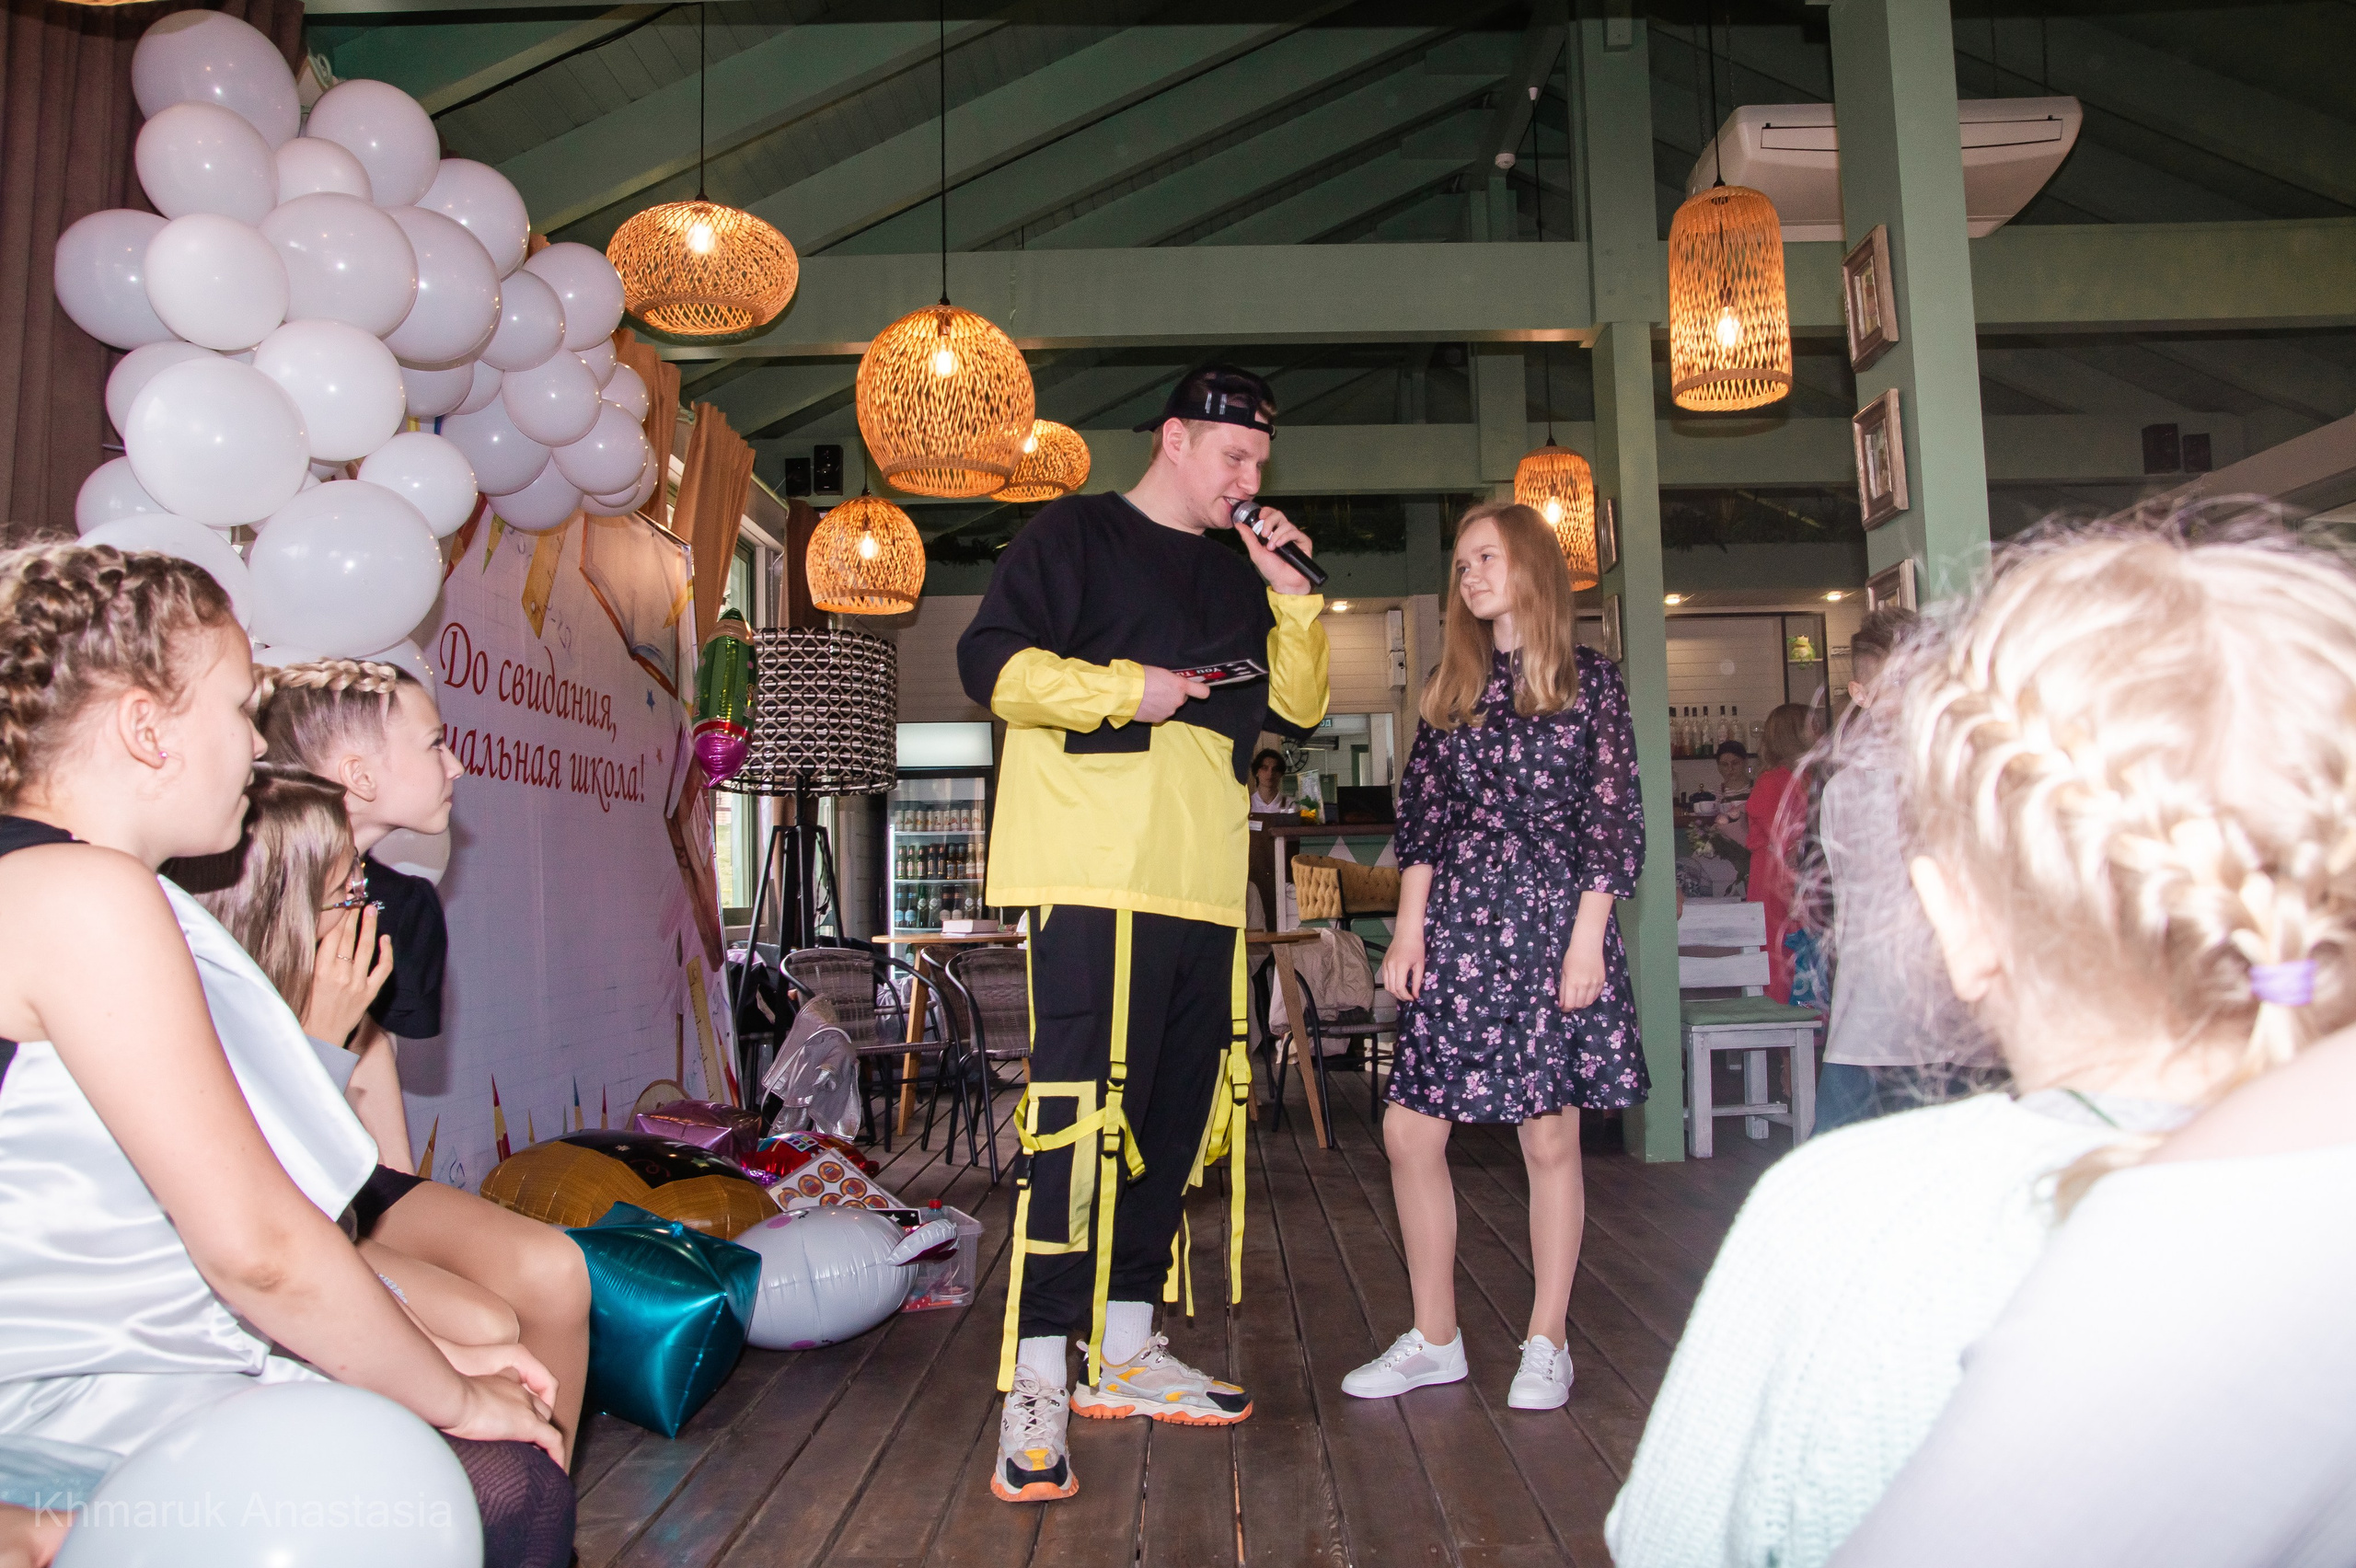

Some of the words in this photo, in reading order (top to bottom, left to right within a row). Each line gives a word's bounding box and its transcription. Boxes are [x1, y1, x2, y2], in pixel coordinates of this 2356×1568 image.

[439, 622, 489, 696] До
[498, 645, 618, 743] свидания,
[442, 722, 562, 790] чальная
[570, 752, 646, 813] школа!
